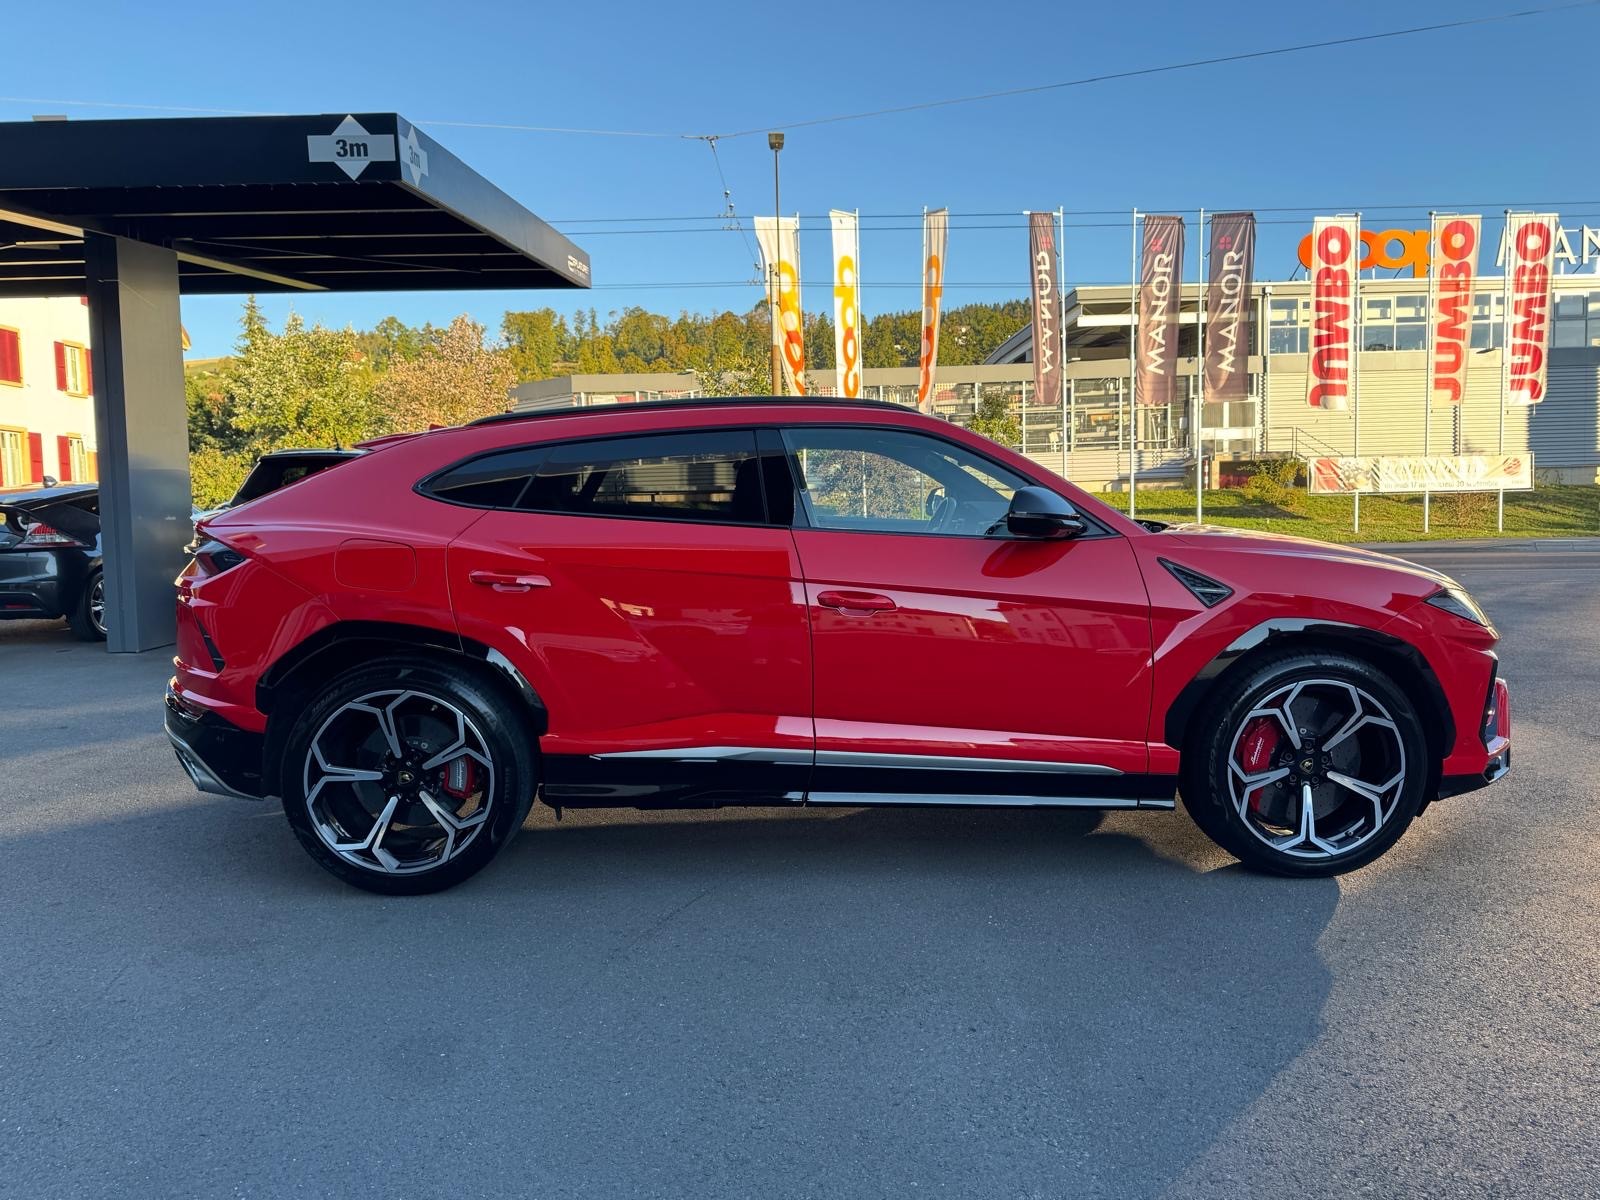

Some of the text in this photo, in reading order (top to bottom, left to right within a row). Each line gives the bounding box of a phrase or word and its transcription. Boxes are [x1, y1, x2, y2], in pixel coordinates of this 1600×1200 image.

[336, 139, 369, 158] 3m
[408, 145, 421, 169] 3m
[834, 255, 859, 399] coop
[1146, 252, 1174, 375] MANOR
[1217, 250, 1244, 373] MANOR
[1434, 220, 1476, 401] JUMBO
[1509, 222, 1552, 401] JUMBO
